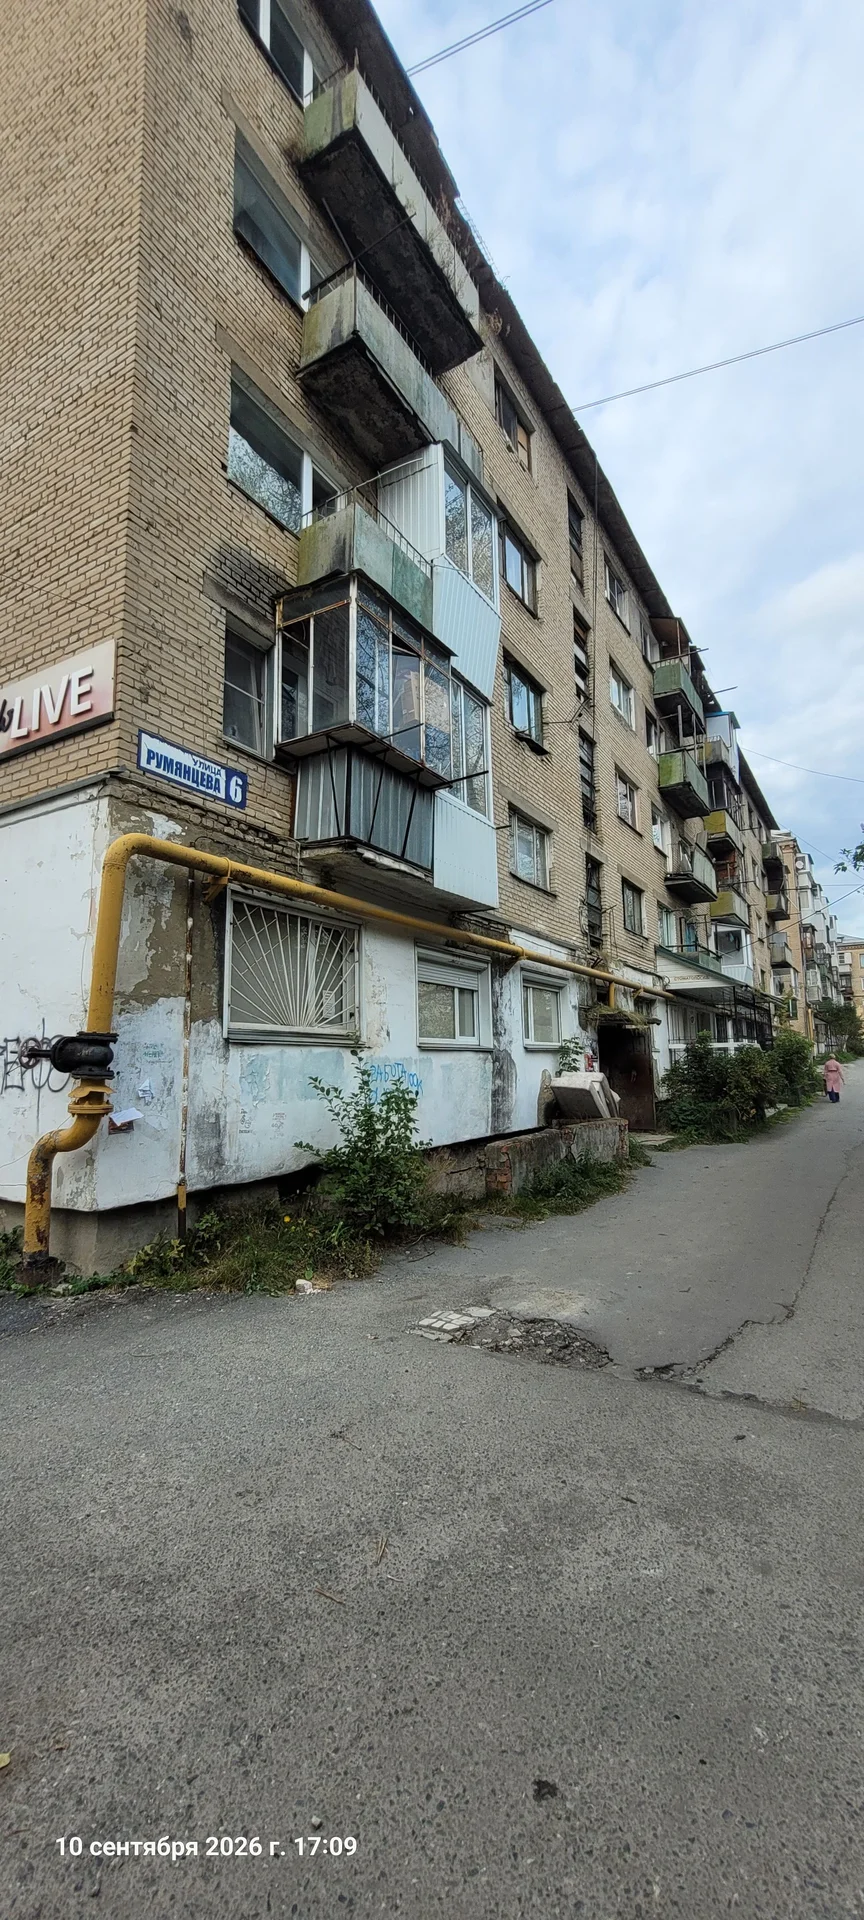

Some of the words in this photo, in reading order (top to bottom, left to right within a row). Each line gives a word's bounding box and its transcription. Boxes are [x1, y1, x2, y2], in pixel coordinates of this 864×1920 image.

[11, 665, 93, 739] LIVE
[146, 748, 222, 794] РУМЯНЦЕВА
[191, 754, 222, 778] УЛИЦА
[229, 775, 243, 803] 6
